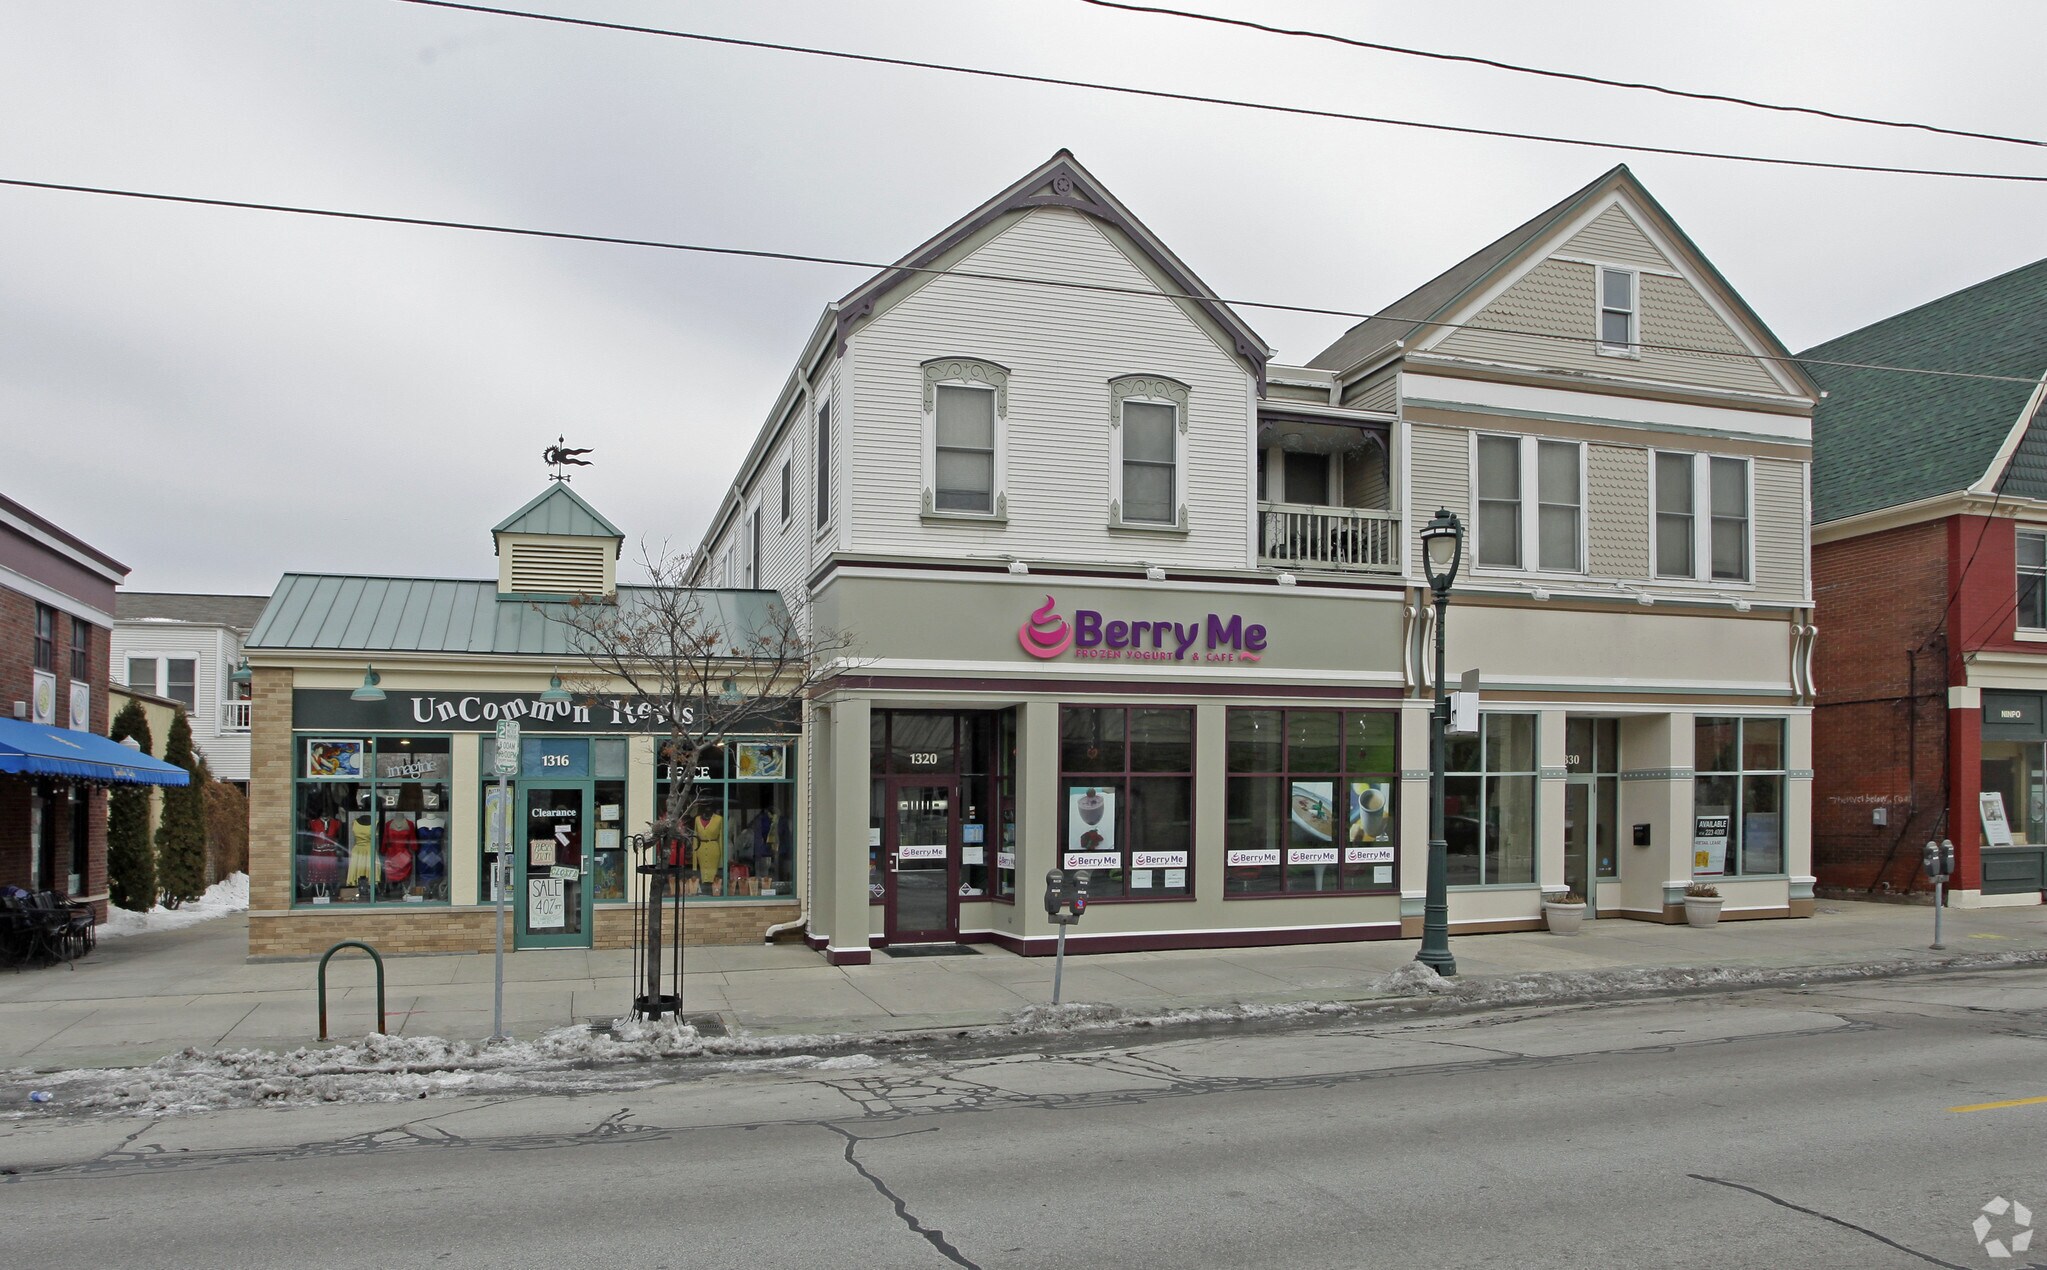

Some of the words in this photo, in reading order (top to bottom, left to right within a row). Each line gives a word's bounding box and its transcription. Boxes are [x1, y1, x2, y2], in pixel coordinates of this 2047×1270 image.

[1076, 609, 1199, 661] Berry
[1207, 613, 1268, 651] Me
[1075, 649, 1121, 659] FROZEN
[1127, 651, 1173, 661] YOGURT
[1191, 652, 1200, 662] &
[1206, 653, 1235, 662] CAFE
[411, 696, 591, 724] UnCommon
[499, 725, 506, 739] 2
[541, 755, 570, 767] 1316
[909, 753, 938, 765] 1320
[386, 760, 438, 780] imagine
[667, 766, 711, 779] PECE
[531, 808, 577, 818] Clearance
[1698, 820, 1727, 828] AVAILABLE
[1705, 828, 1714, 836] 223
[910, 848, 932, 857] Berry
[1240, 853, 1264, 863] Berry
[1264, 853, 1277, 861] Me
[1300, 852, 1323, 862] Berry
[1323, 852, 1335, 860] Me
[1357, 851, 1379, 860] Berry
[1379, 851, 1391, 859] Me
[1078, 856, 1104, 866] Berry
[1104, 856, 1117, 864] Me
[1146, 855, 1170, 865] Berry
[1170, 855, 1183, 863] Me
[551, 868, 578, 879] CLOSED
[532, 879, 563, 898] SALE
